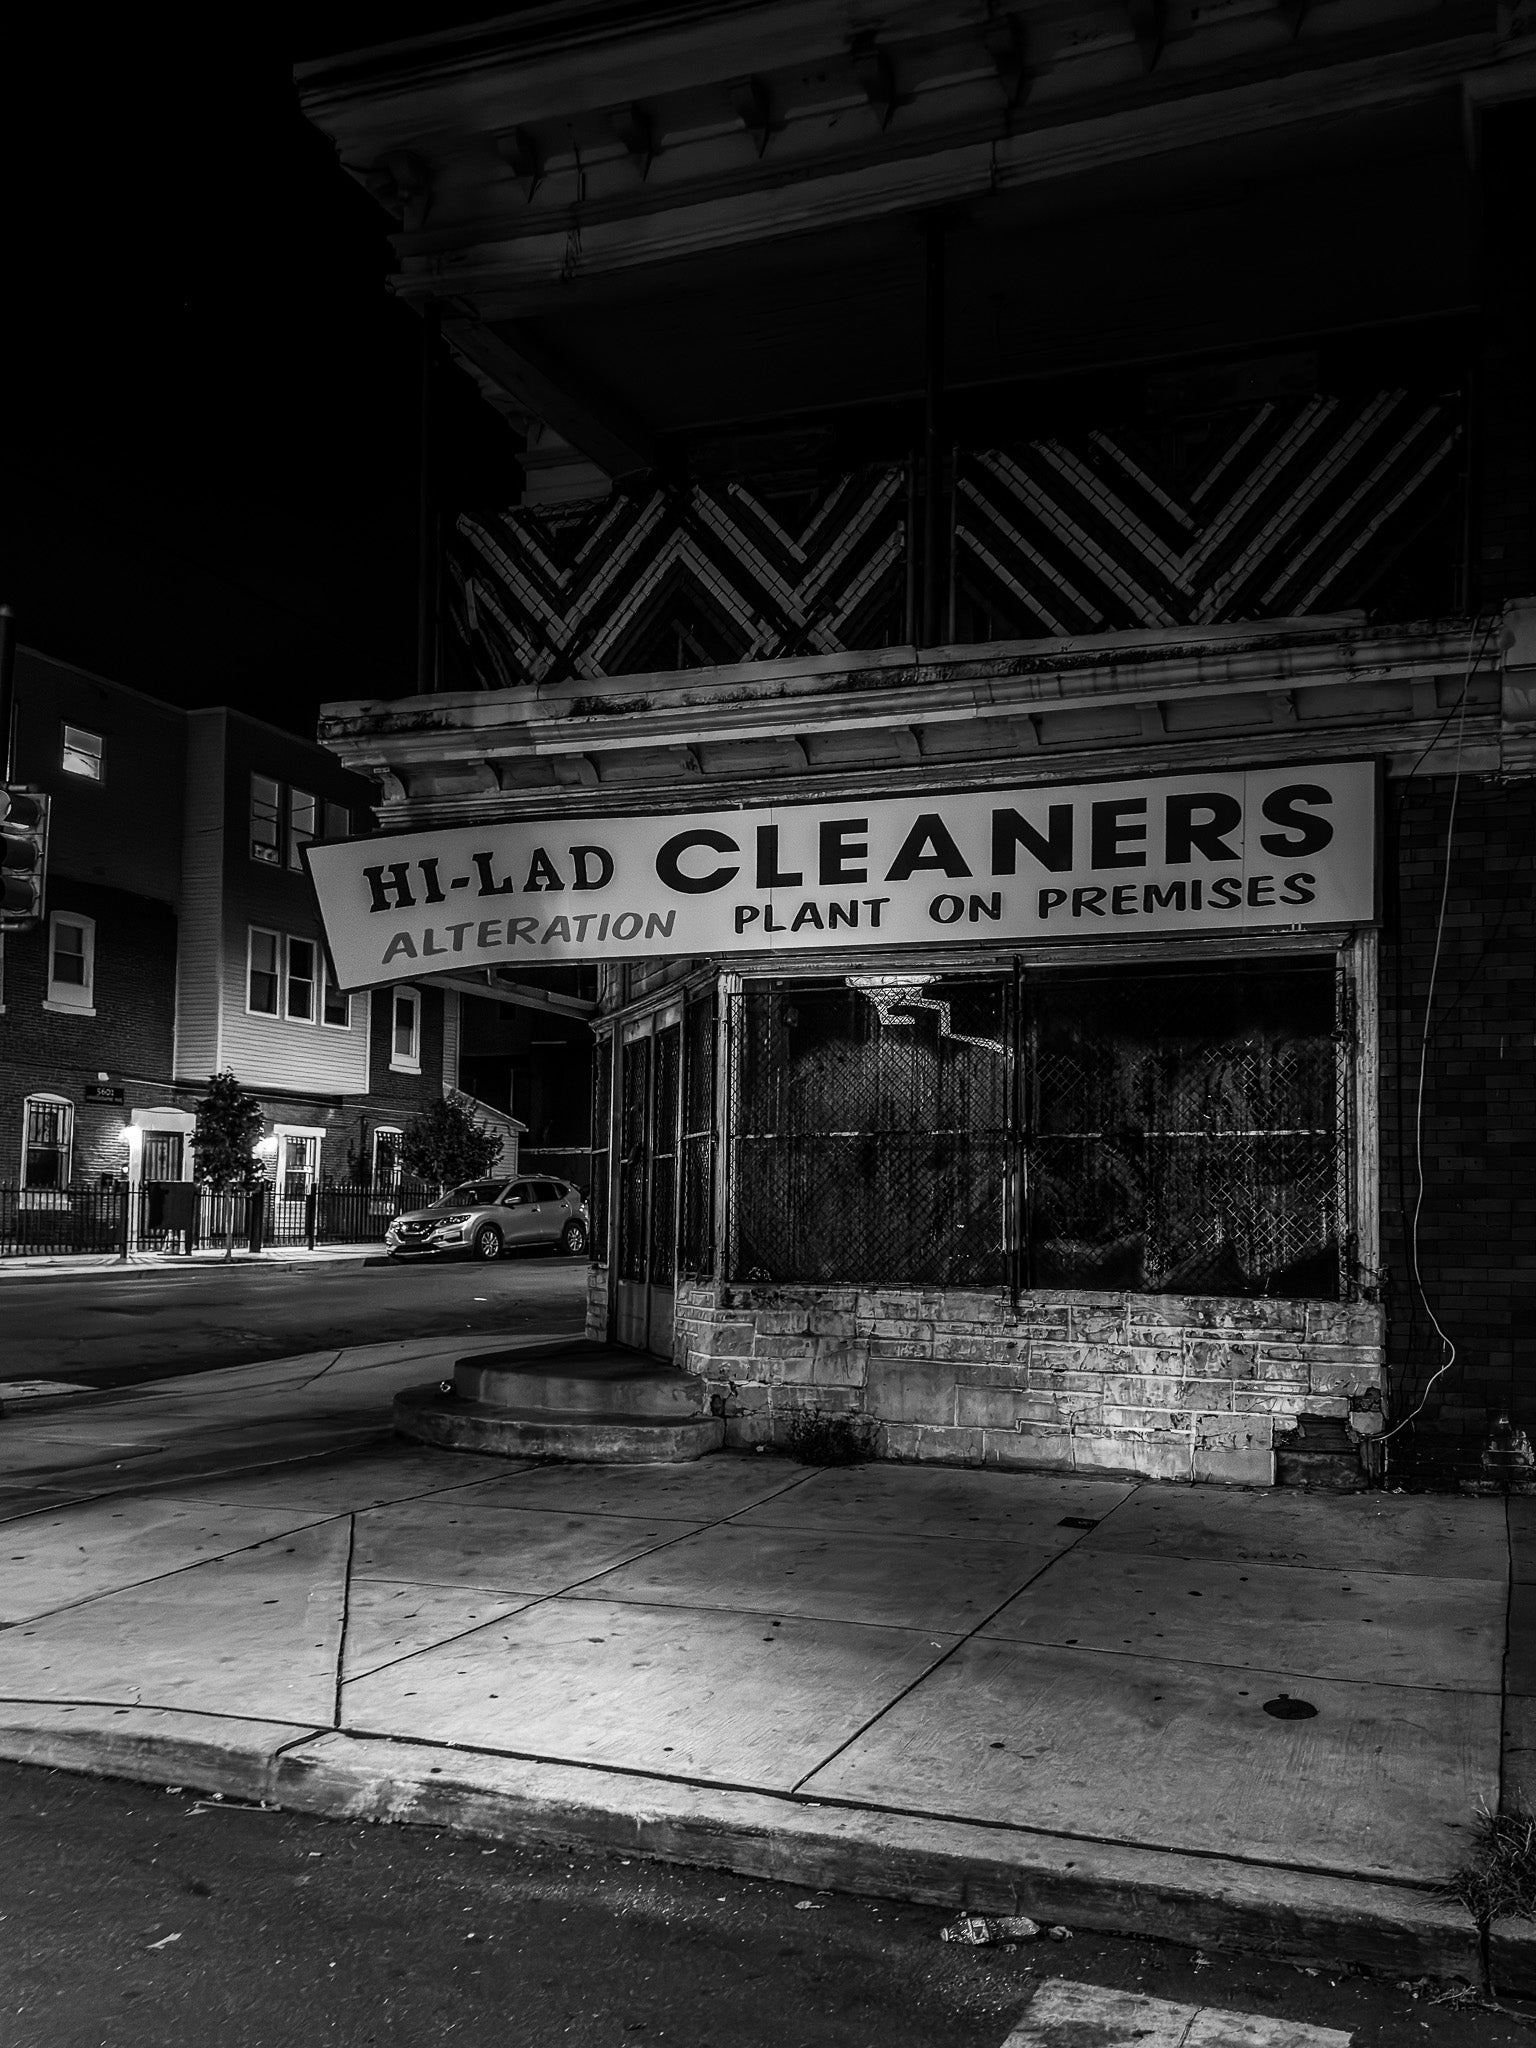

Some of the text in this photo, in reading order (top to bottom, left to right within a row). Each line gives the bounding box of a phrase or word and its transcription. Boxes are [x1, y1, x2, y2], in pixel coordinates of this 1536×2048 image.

[362, 783, 1334, 914] HI-LAD CLEANERS
[381, 872, 1316, 965] ALTERATION PLANT ON PREMISES
